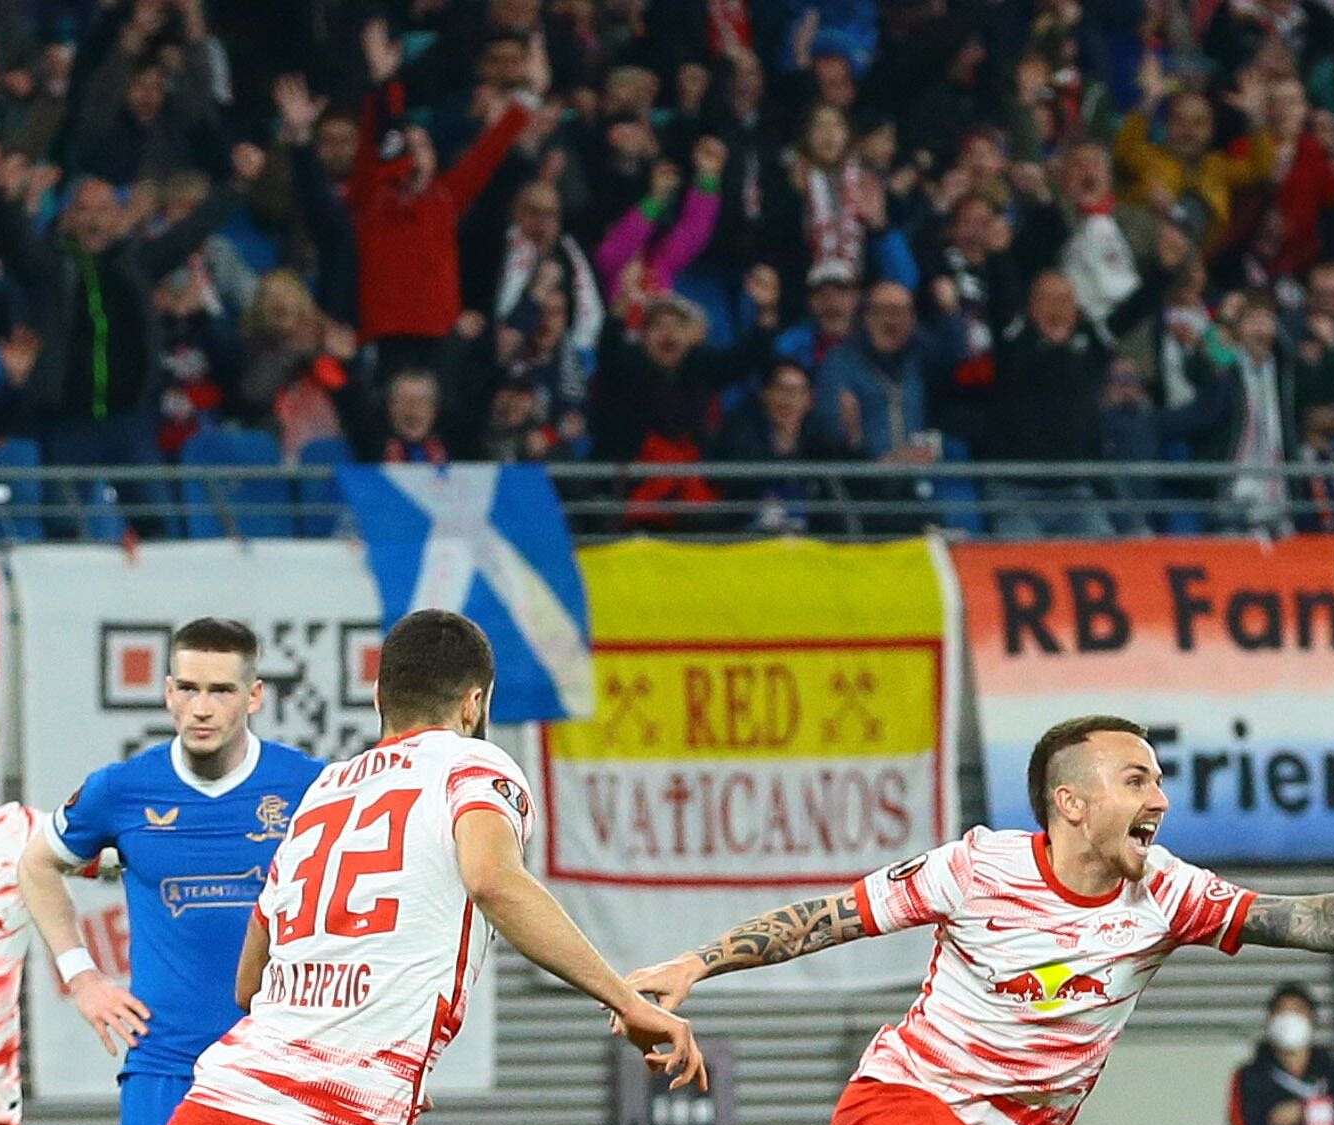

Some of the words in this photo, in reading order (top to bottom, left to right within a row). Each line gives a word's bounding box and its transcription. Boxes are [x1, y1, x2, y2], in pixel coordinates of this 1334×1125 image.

[995, 566, 1132, 656] RB
[685, 664, 801, 748] RED
[585, 768, 912, 858] VATICANOS
[276, 788, 423, 945] 32
[268, 962, 287, 1004] RB
[290, 962, 372, 1009] LEIPZIG
